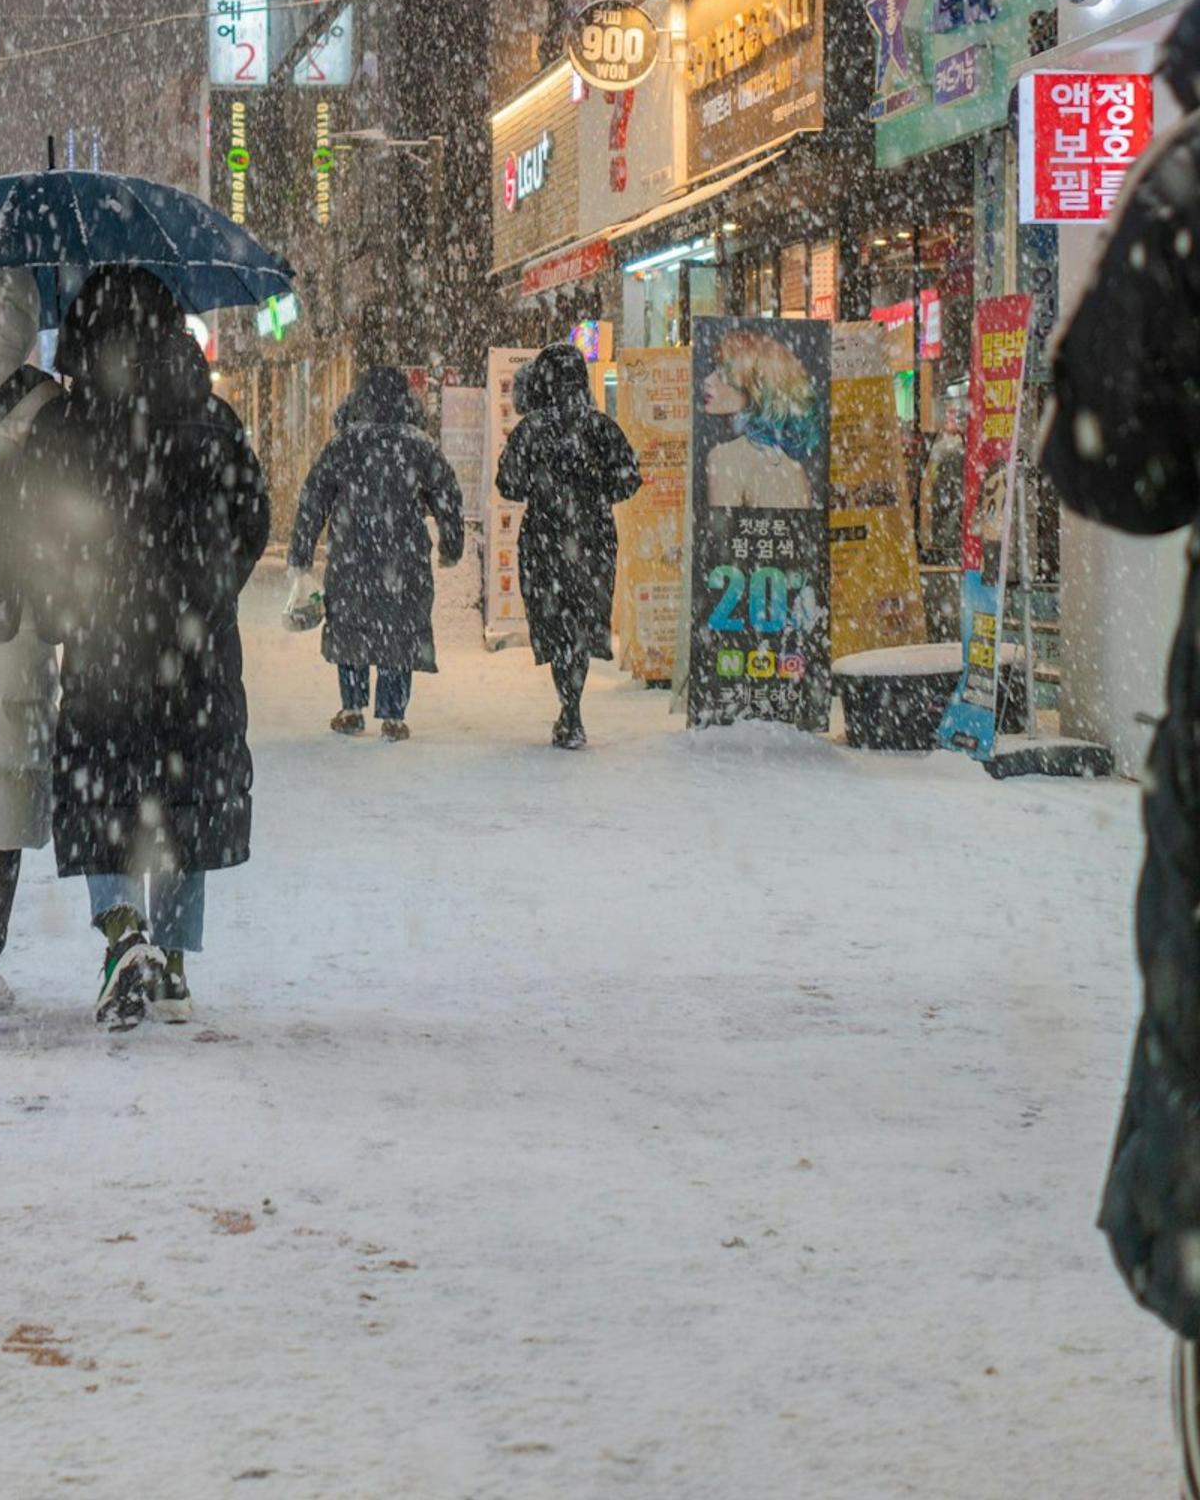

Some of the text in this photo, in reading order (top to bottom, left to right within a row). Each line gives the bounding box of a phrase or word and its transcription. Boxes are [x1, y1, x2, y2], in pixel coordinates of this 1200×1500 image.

[234, 42, 257, 81] 2
[582, 25, 645, 64] 900
[596, 63, 629, 80] WON
[1050, 81, 1136, 126] 액정
[231, 100, 246, 148] OLIVE
[1049, 125, 1137, 166] 보호
[231, 171, 246, 225] YOUNG
[738, 518, 790, 537] 첫방문
